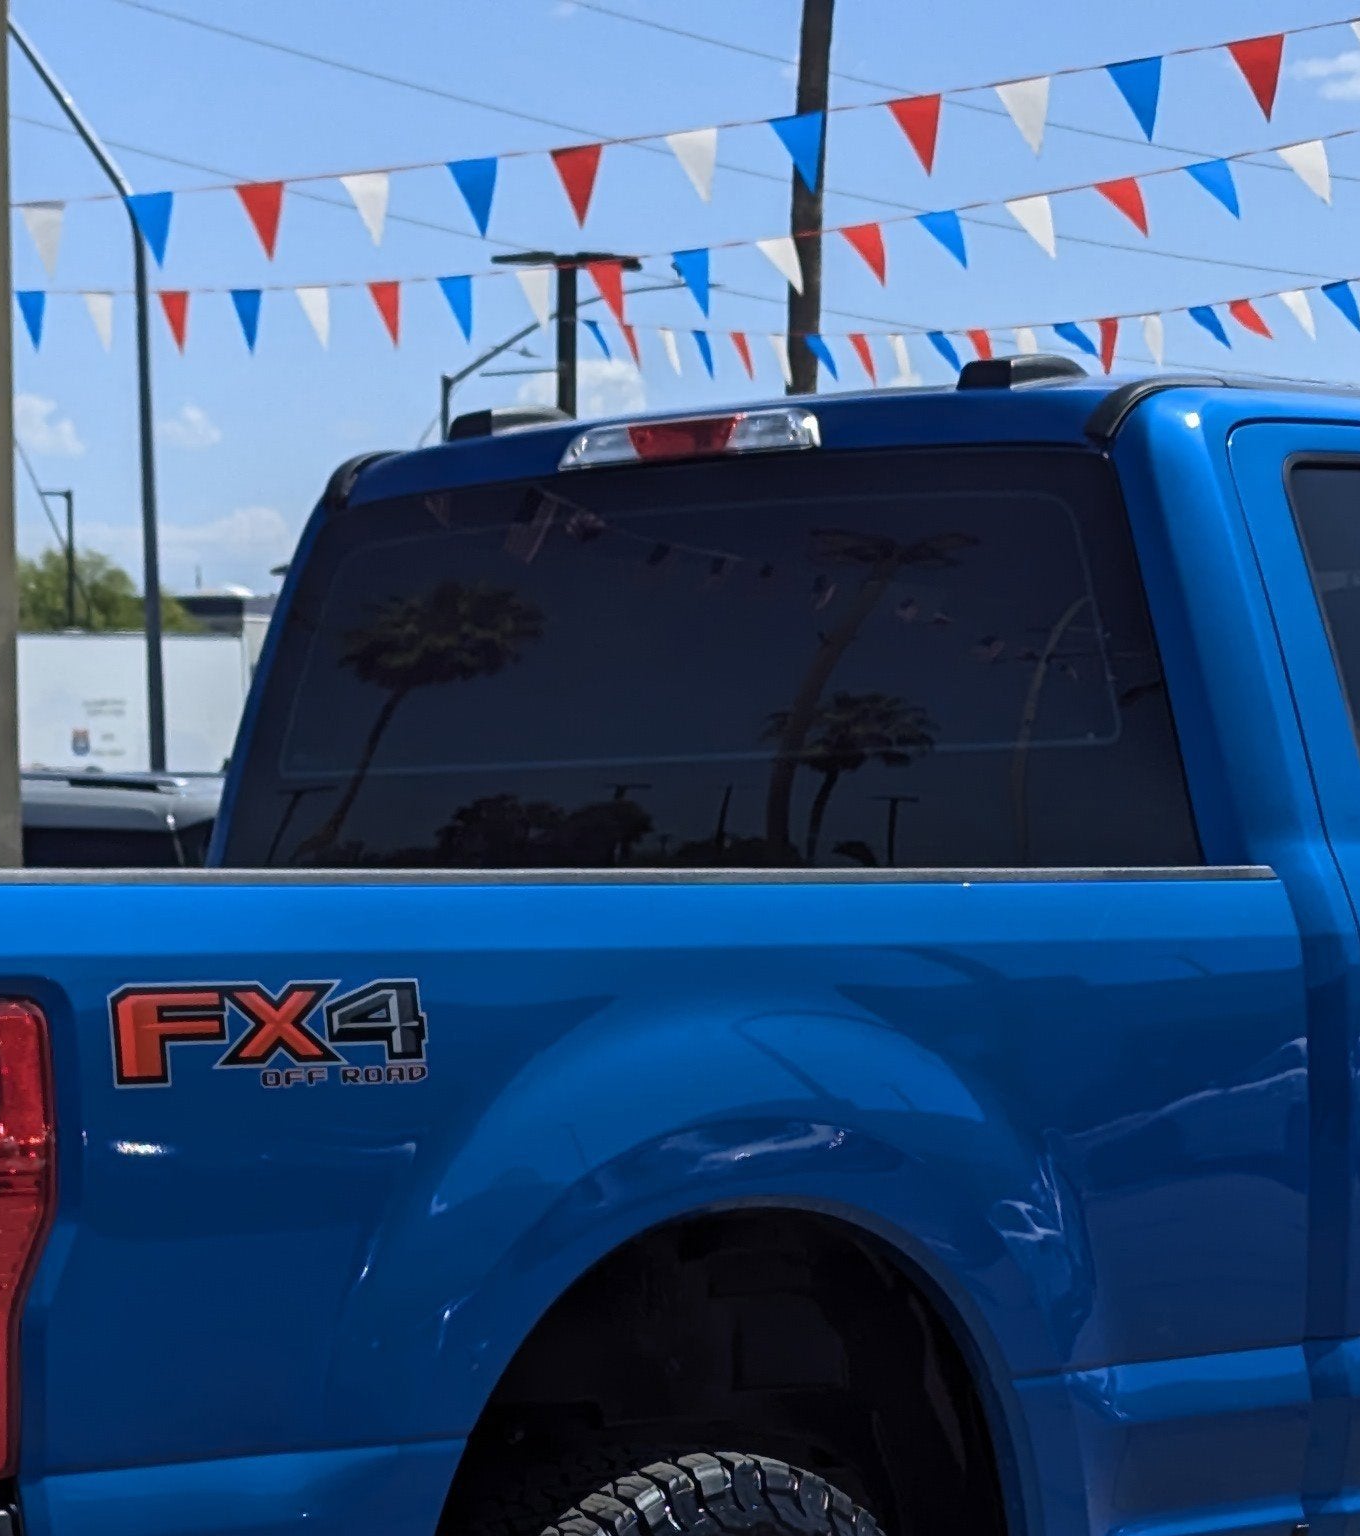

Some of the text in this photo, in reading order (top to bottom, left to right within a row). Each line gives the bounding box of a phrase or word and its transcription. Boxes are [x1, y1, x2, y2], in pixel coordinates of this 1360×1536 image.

[106, 978, 428, 1089] FX4
[260, 1064, 428, 1089] OFF ROAD
